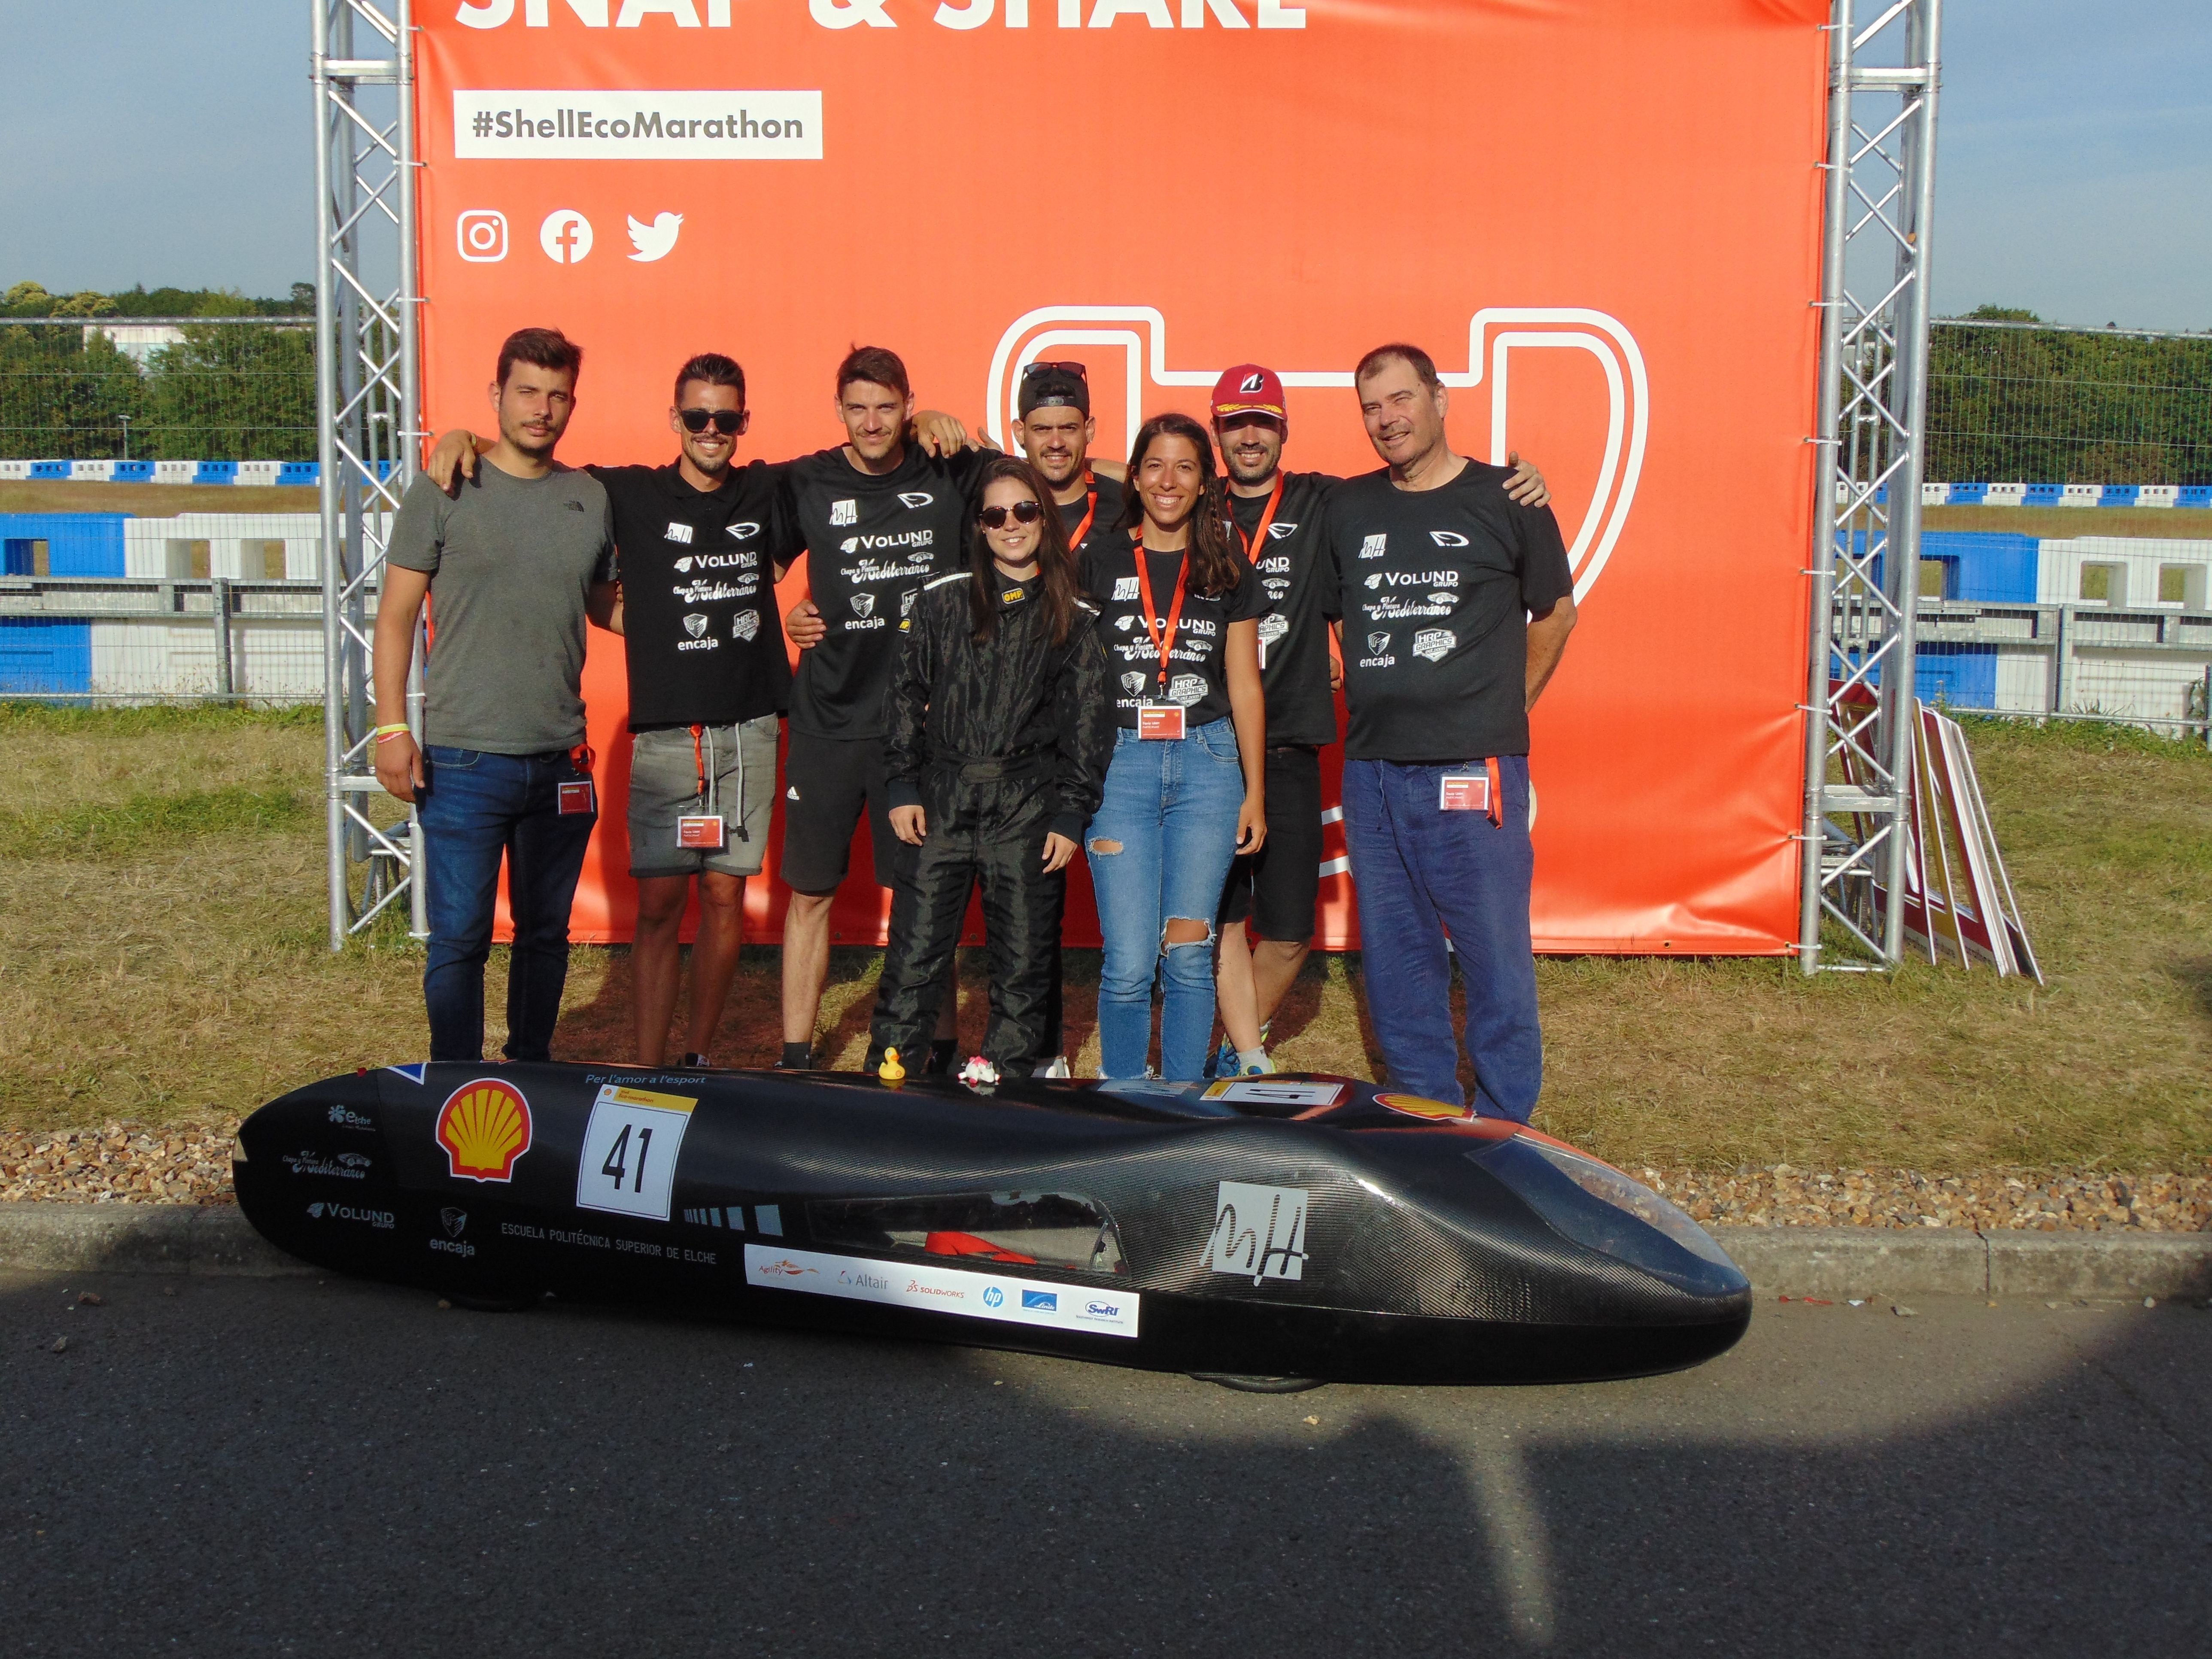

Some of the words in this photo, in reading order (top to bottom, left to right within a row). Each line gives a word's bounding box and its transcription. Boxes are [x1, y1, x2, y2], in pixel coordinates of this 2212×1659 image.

[472, 109, 803, 140] #ShellEcoMarathon
[860, 530, 933, 549] VOLUND
[912, 539, 933, 547] GRUPO
[695, 551, 757, 568] VOLUND
[841, 568, 855, 576] Chapa
[1385, 571, 1458, 586] VOLUND
[1362, 603, 1376, 611] Chapa
[845, 616, 885, 630] encaja
[1138, 616, 1216, 631] VOUND
[1260, 623, 1285, 632] APHICS
[1193, 628, 1216, 637] GRUPO
[1419, 632, 1441, 643] HRP
[678, 636, 718, 650] encaja
[1114, 644, 1129, 652] Chapa
[1135, 642, 1154, 650] Pintura
[1416, 638, 1452, 650] GRAPHICS
[1360, 654, 1395, 668] encaja
[1175, 679, 1197, 688] HRP
[1172, 686, 1206, 696] GRAPHICS
[585, 1074, 605, 1084] Per
[608, 1074, 647, 1084] l'amor
[659, 1076, 706, 1086] l'esport
[602, 1124, 653, 1194] 41
[327, 1203, 394, 1223] VOLUND
[430, 1239, 475, 1258] encaja
[502, 1223, 544, 1239] ESCUELA
[550, 1229, 610, 1249] POLITÉCNICA
[616, 1239, 661, 1256] SUPERIOR
[667, 1247, 679, 1259] DE
[685, 1249, 717, 1264] ELCHE
[759, 1266, 783, 1276] Agility
[856, 1274, 888, 1289] Altair
[920, 1287, 964, 1298] SOLIDWORKS
[985, 1287, 1003, 1307] hp
[1034, 1302, 1055, 1310] Linde
